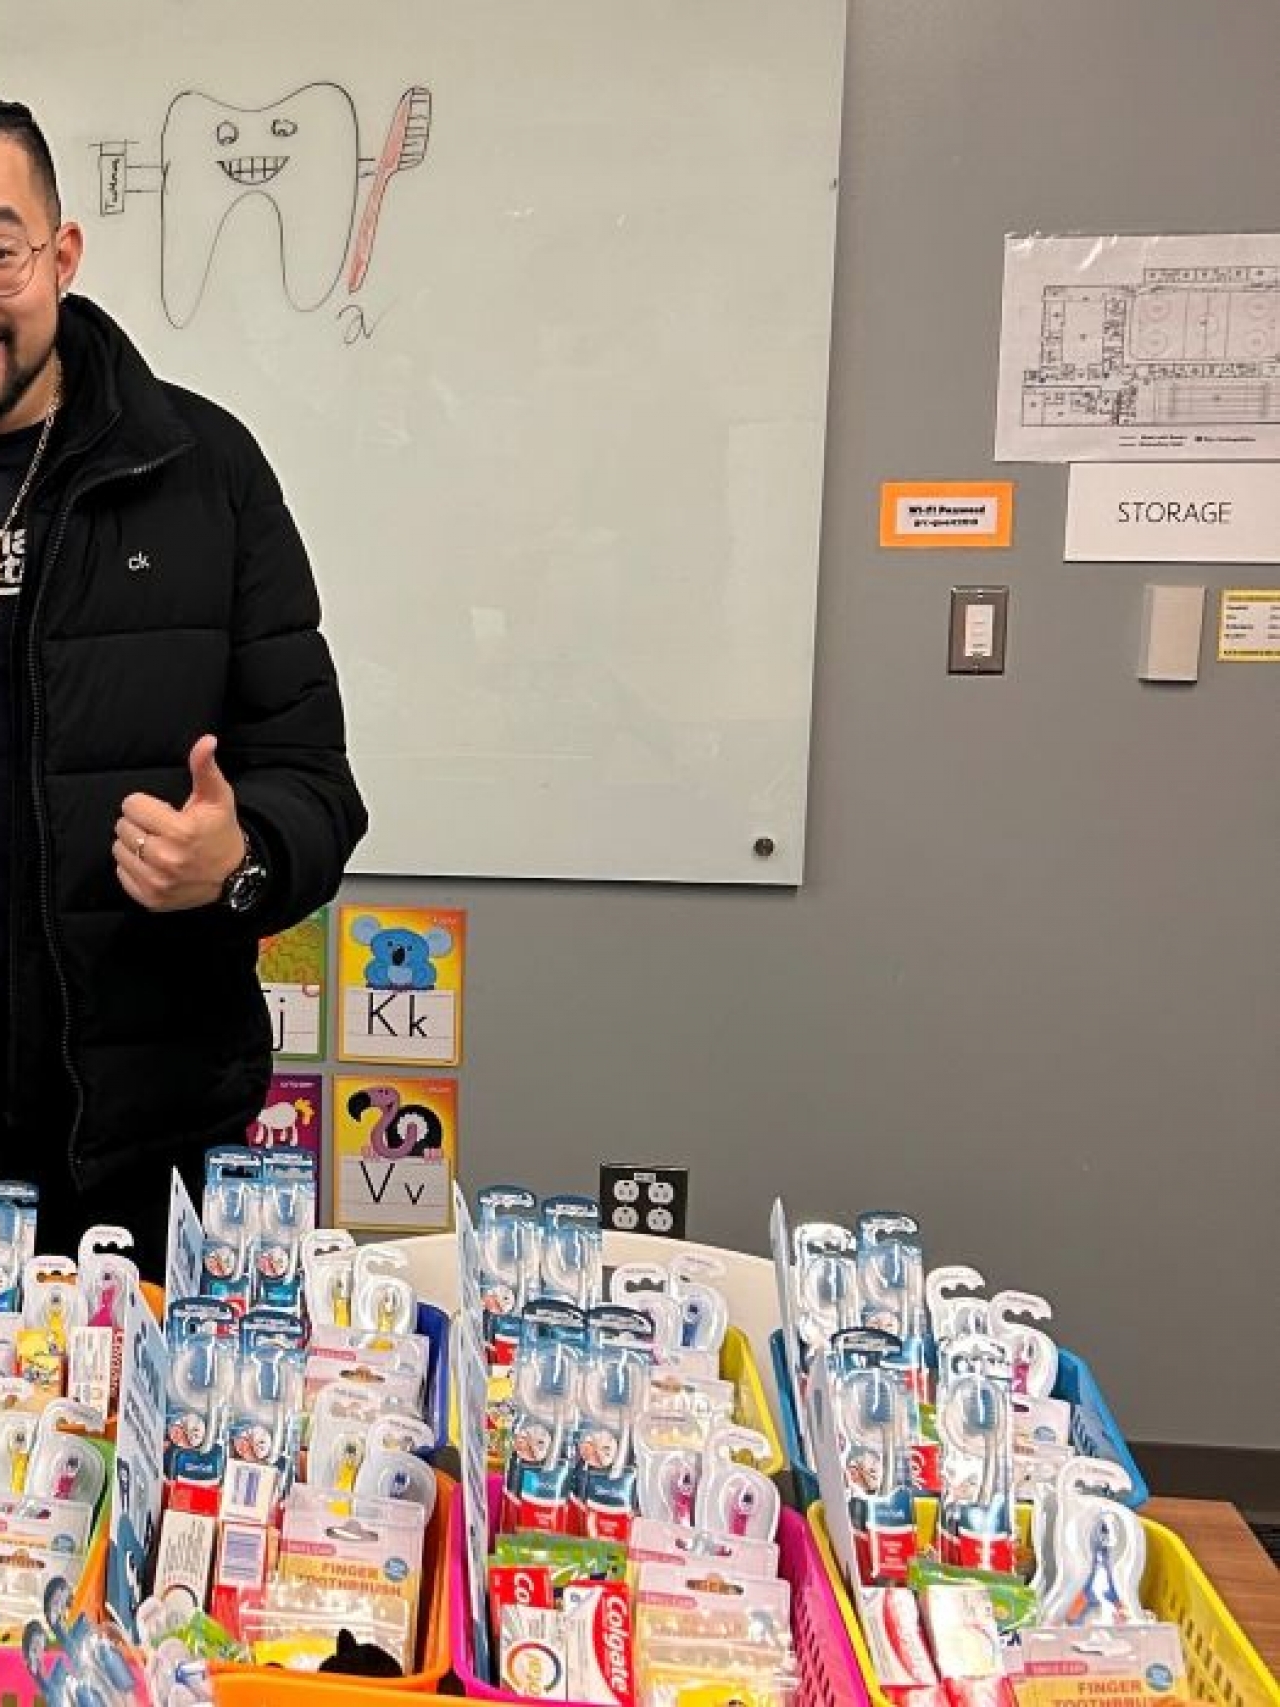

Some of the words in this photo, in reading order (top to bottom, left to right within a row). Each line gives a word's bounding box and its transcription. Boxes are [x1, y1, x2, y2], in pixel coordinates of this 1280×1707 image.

[1118, 501, 1232, 523] STORAGE
[128, 551, 150, 570] ck
[321, 1562, 379, 1580] FINGER
[602, 1596, 630, 1695] Colgate
[1076, 1680, 1143, 1695] FINGER
